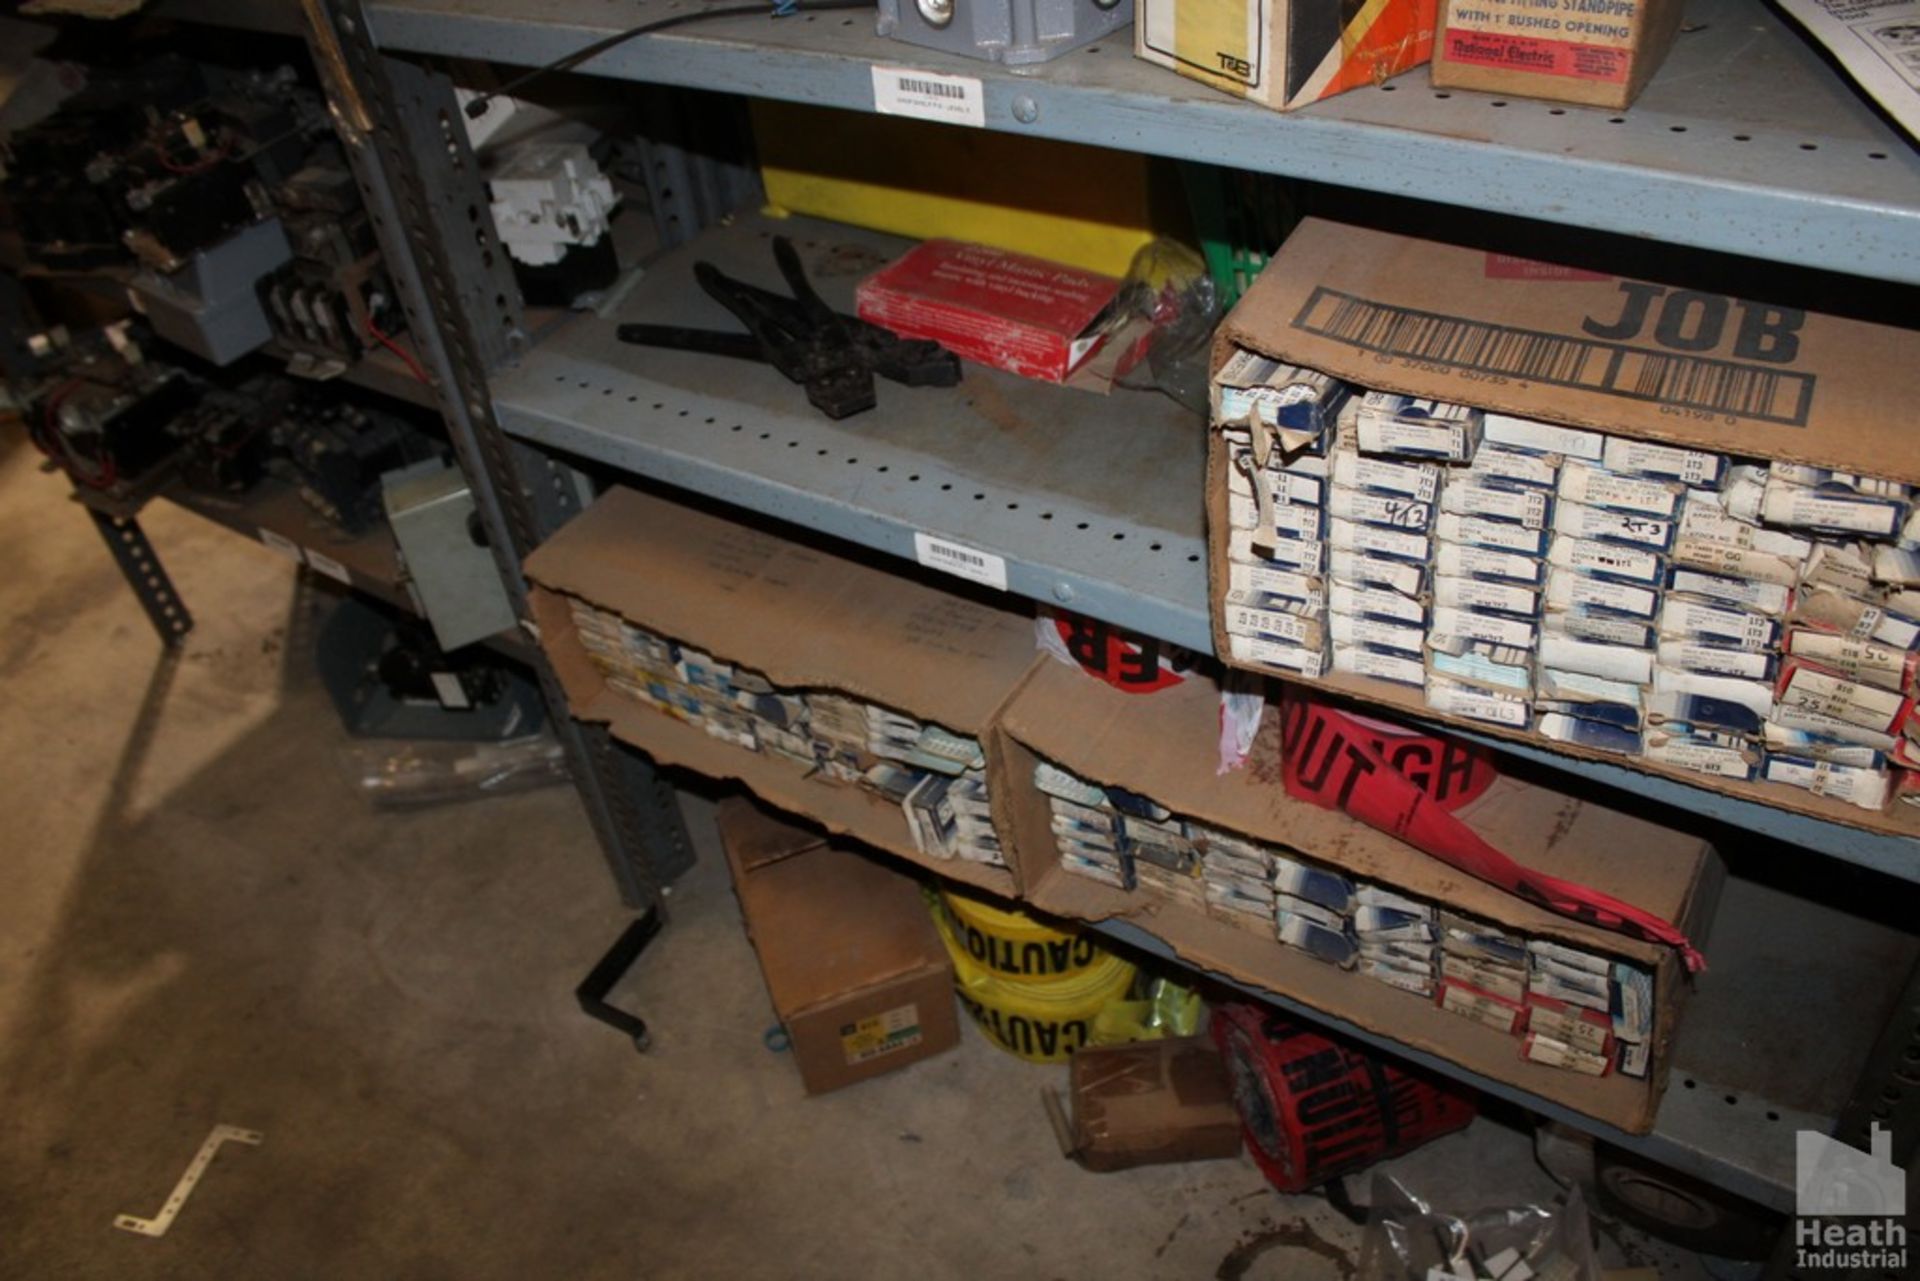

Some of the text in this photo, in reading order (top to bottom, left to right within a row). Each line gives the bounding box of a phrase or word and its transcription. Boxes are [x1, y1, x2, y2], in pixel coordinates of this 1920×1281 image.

[1562, 0, 1635, 17] STANDPIPE
[1456, 9, 1490, 22] WITH
[1508, 14, 1561, 30] BUSHED
[1565, 20, 1629, 39] OPENING
[1452, 38, 1504, 57] National
[1508, 45, 1555, 62] Electric
[1582, 281, 1806, 364] JOB
[957, 917, 1097, 976] CAUTIO
